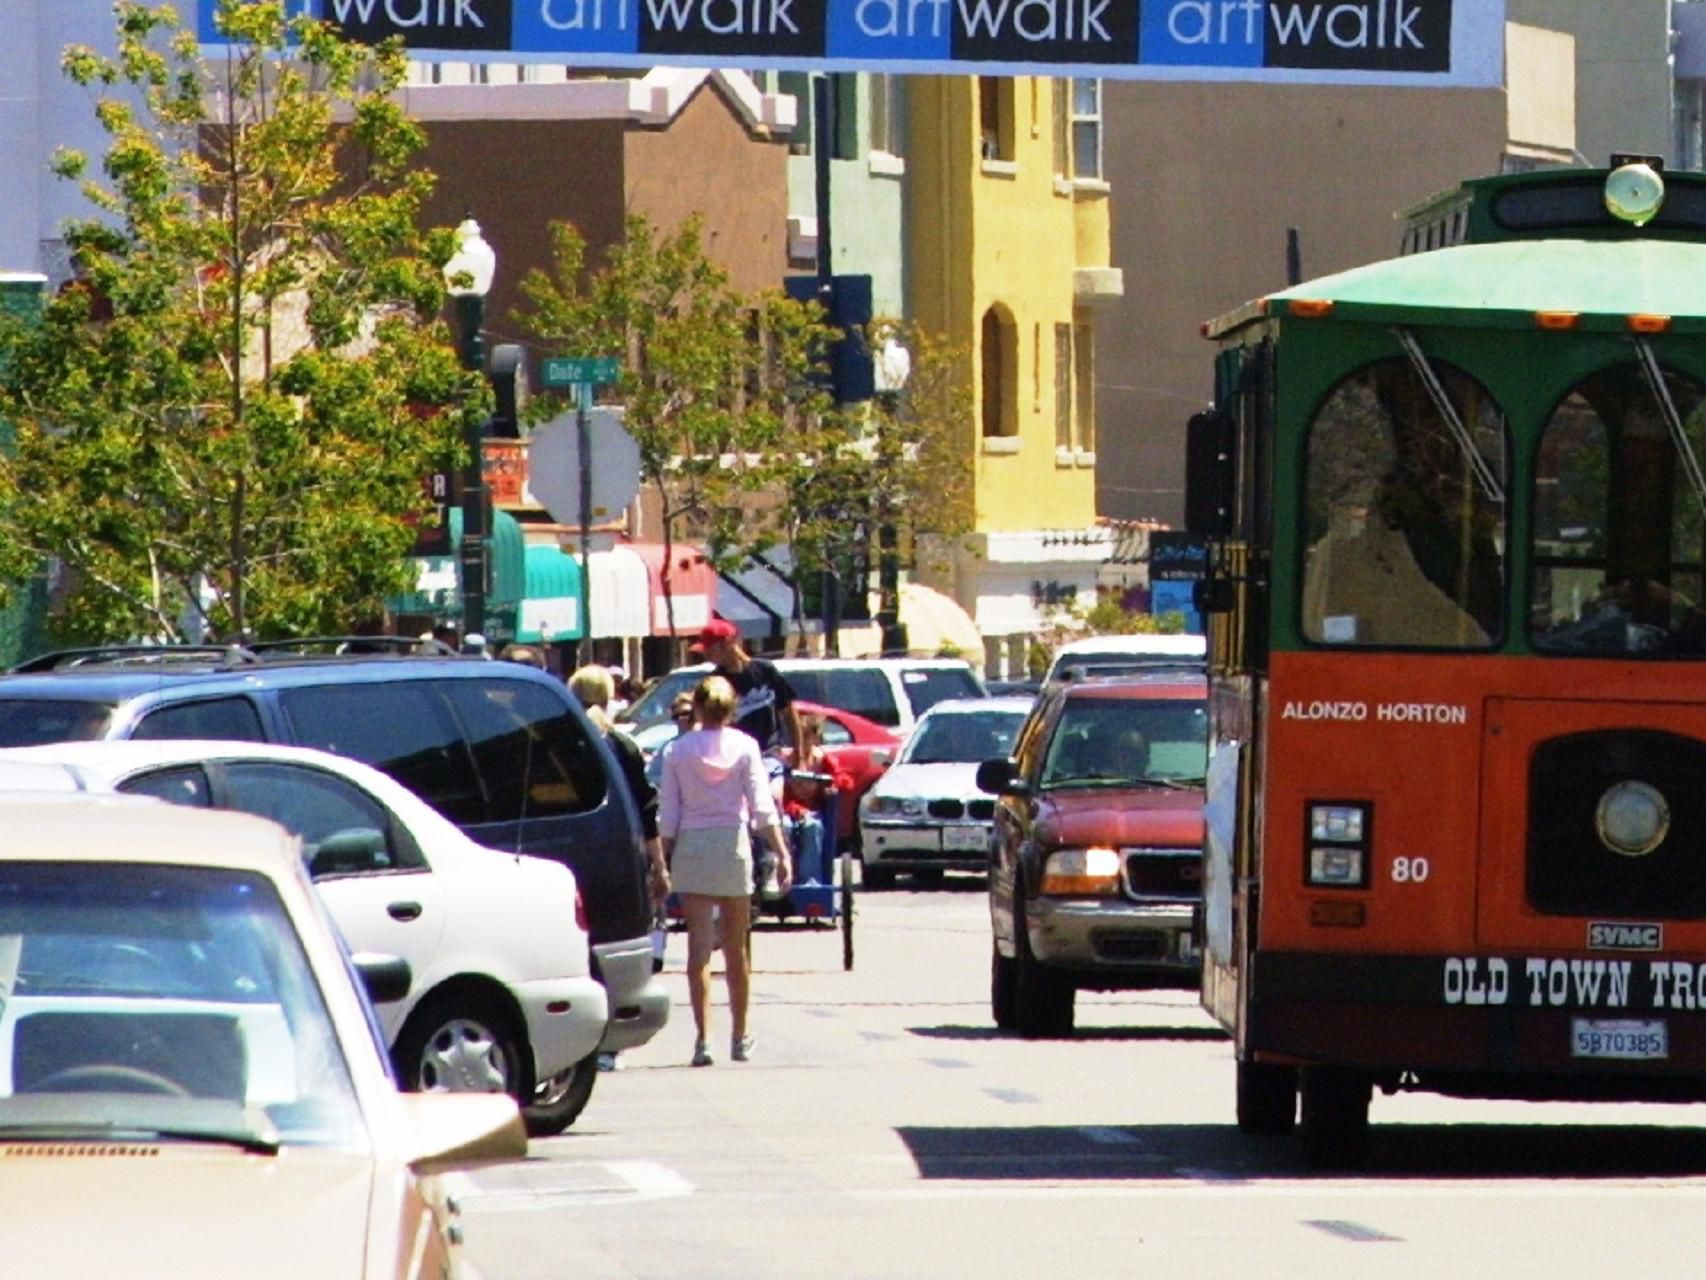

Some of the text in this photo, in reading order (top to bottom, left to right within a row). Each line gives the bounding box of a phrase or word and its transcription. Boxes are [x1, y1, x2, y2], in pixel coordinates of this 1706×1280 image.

[549, 362, 584, 382] Date
[1282, 701, 1467, 725] ALONZO HORTON
[1391, 856, 1429, 882] 80
[1590, 925, 1659, 946] SVMC
[1443, 957, 1510, 1006] OLD
[1525, 958, 1632, 1008] TOWN
